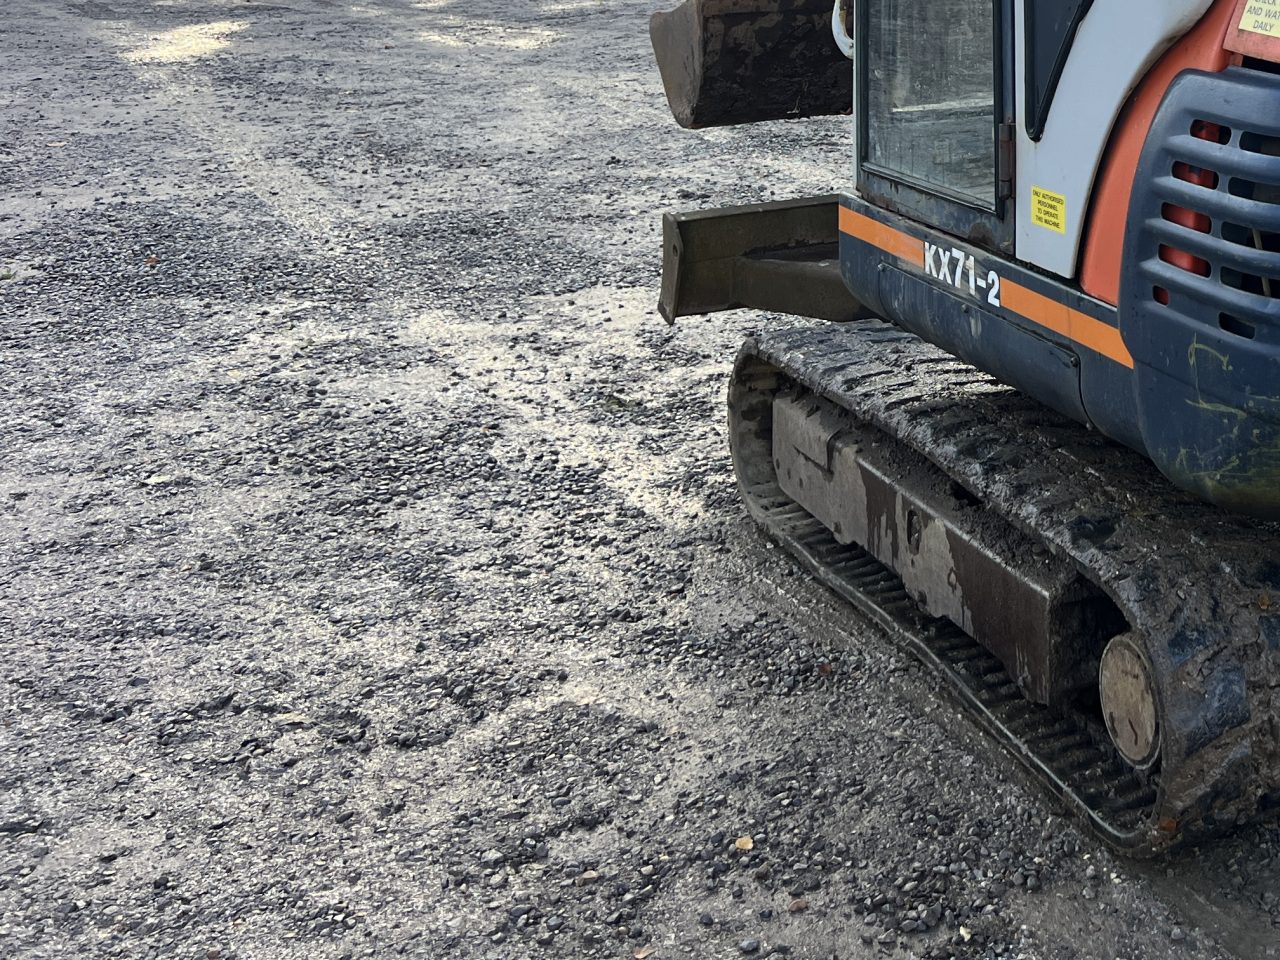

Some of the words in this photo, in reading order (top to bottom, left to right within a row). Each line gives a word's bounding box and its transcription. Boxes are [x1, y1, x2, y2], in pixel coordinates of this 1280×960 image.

[1247, 6, 1262, 16] AND
[1253, 20, 1275, 32] DAILY
[924, 241, 1001, 308] KX71-2
